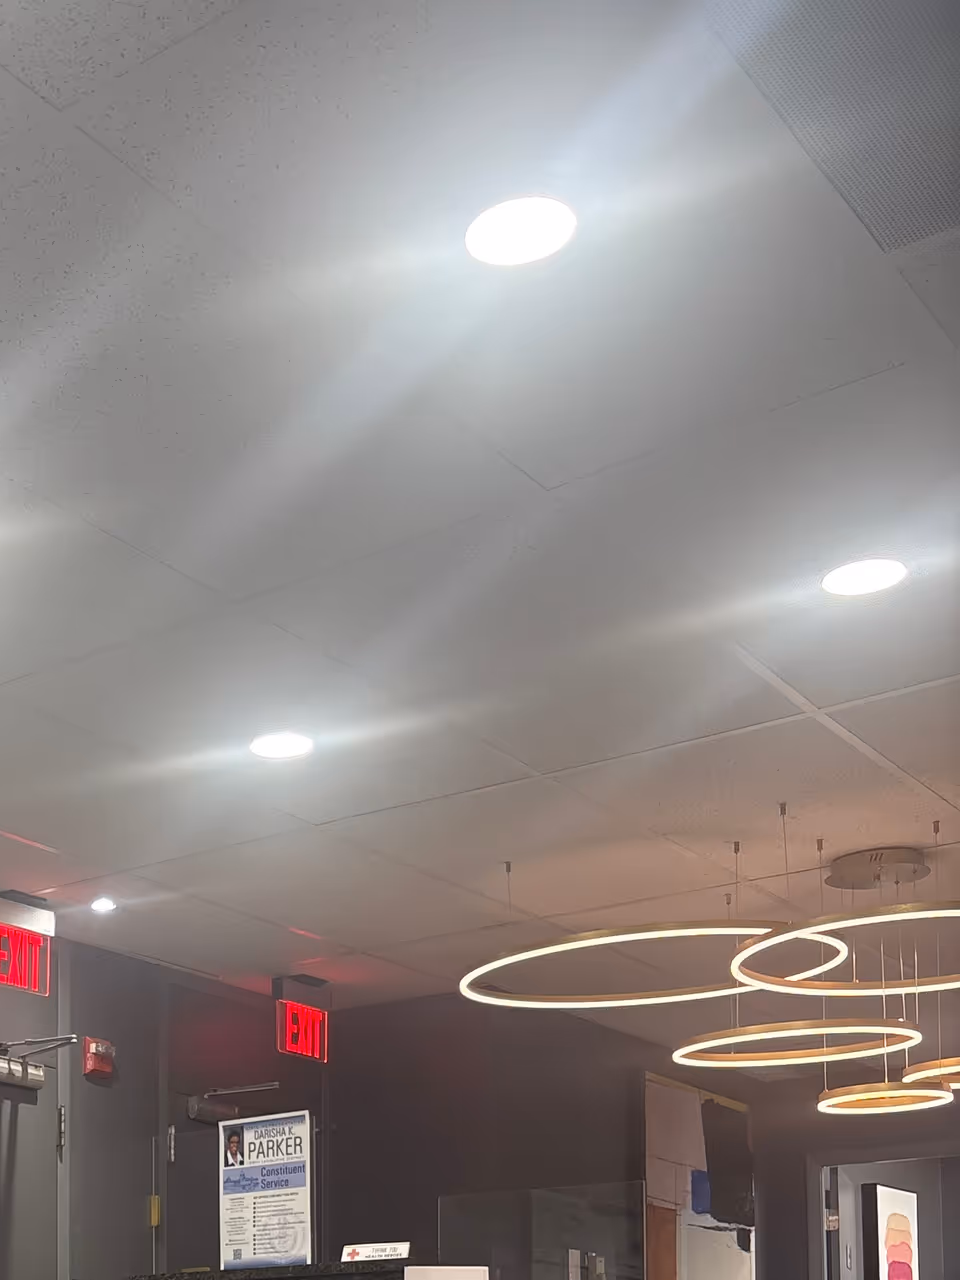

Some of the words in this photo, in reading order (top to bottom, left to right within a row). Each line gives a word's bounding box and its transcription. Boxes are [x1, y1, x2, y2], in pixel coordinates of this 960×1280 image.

[286, 1002, 322, 1058] EXIT
[254, 1127, 286, 1140] DARISHA
[288, 1126, 295, 1135] K.
[248, 1136, 303, 1160] PARKER
[261, 1165, 305, 1177] Constituent
[261, 1179, 289, 1189] Service
